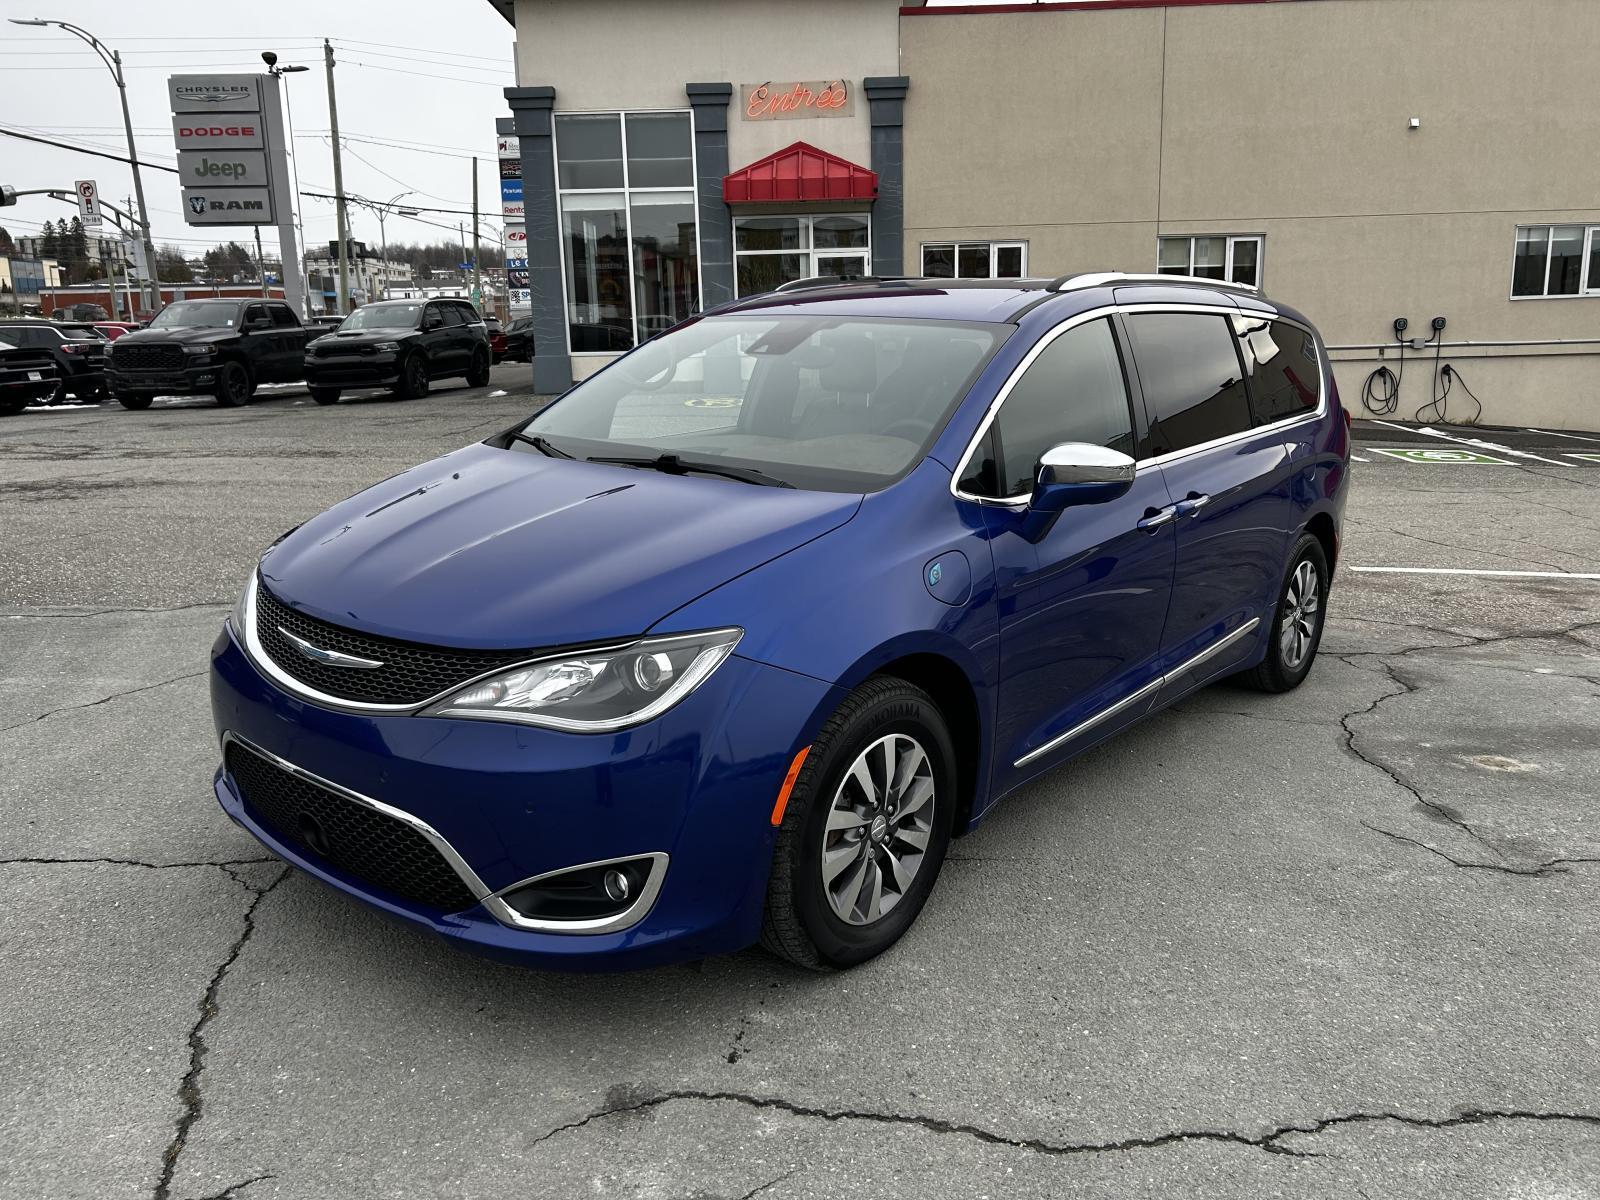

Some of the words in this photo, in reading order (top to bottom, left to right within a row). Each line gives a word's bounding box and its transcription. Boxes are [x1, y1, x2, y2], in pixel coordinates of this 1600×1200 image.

[179, 127, 255, 137] DODGE
[195, 158, 247, 180] Jeep
[210, 201, 263, 210] RAM
